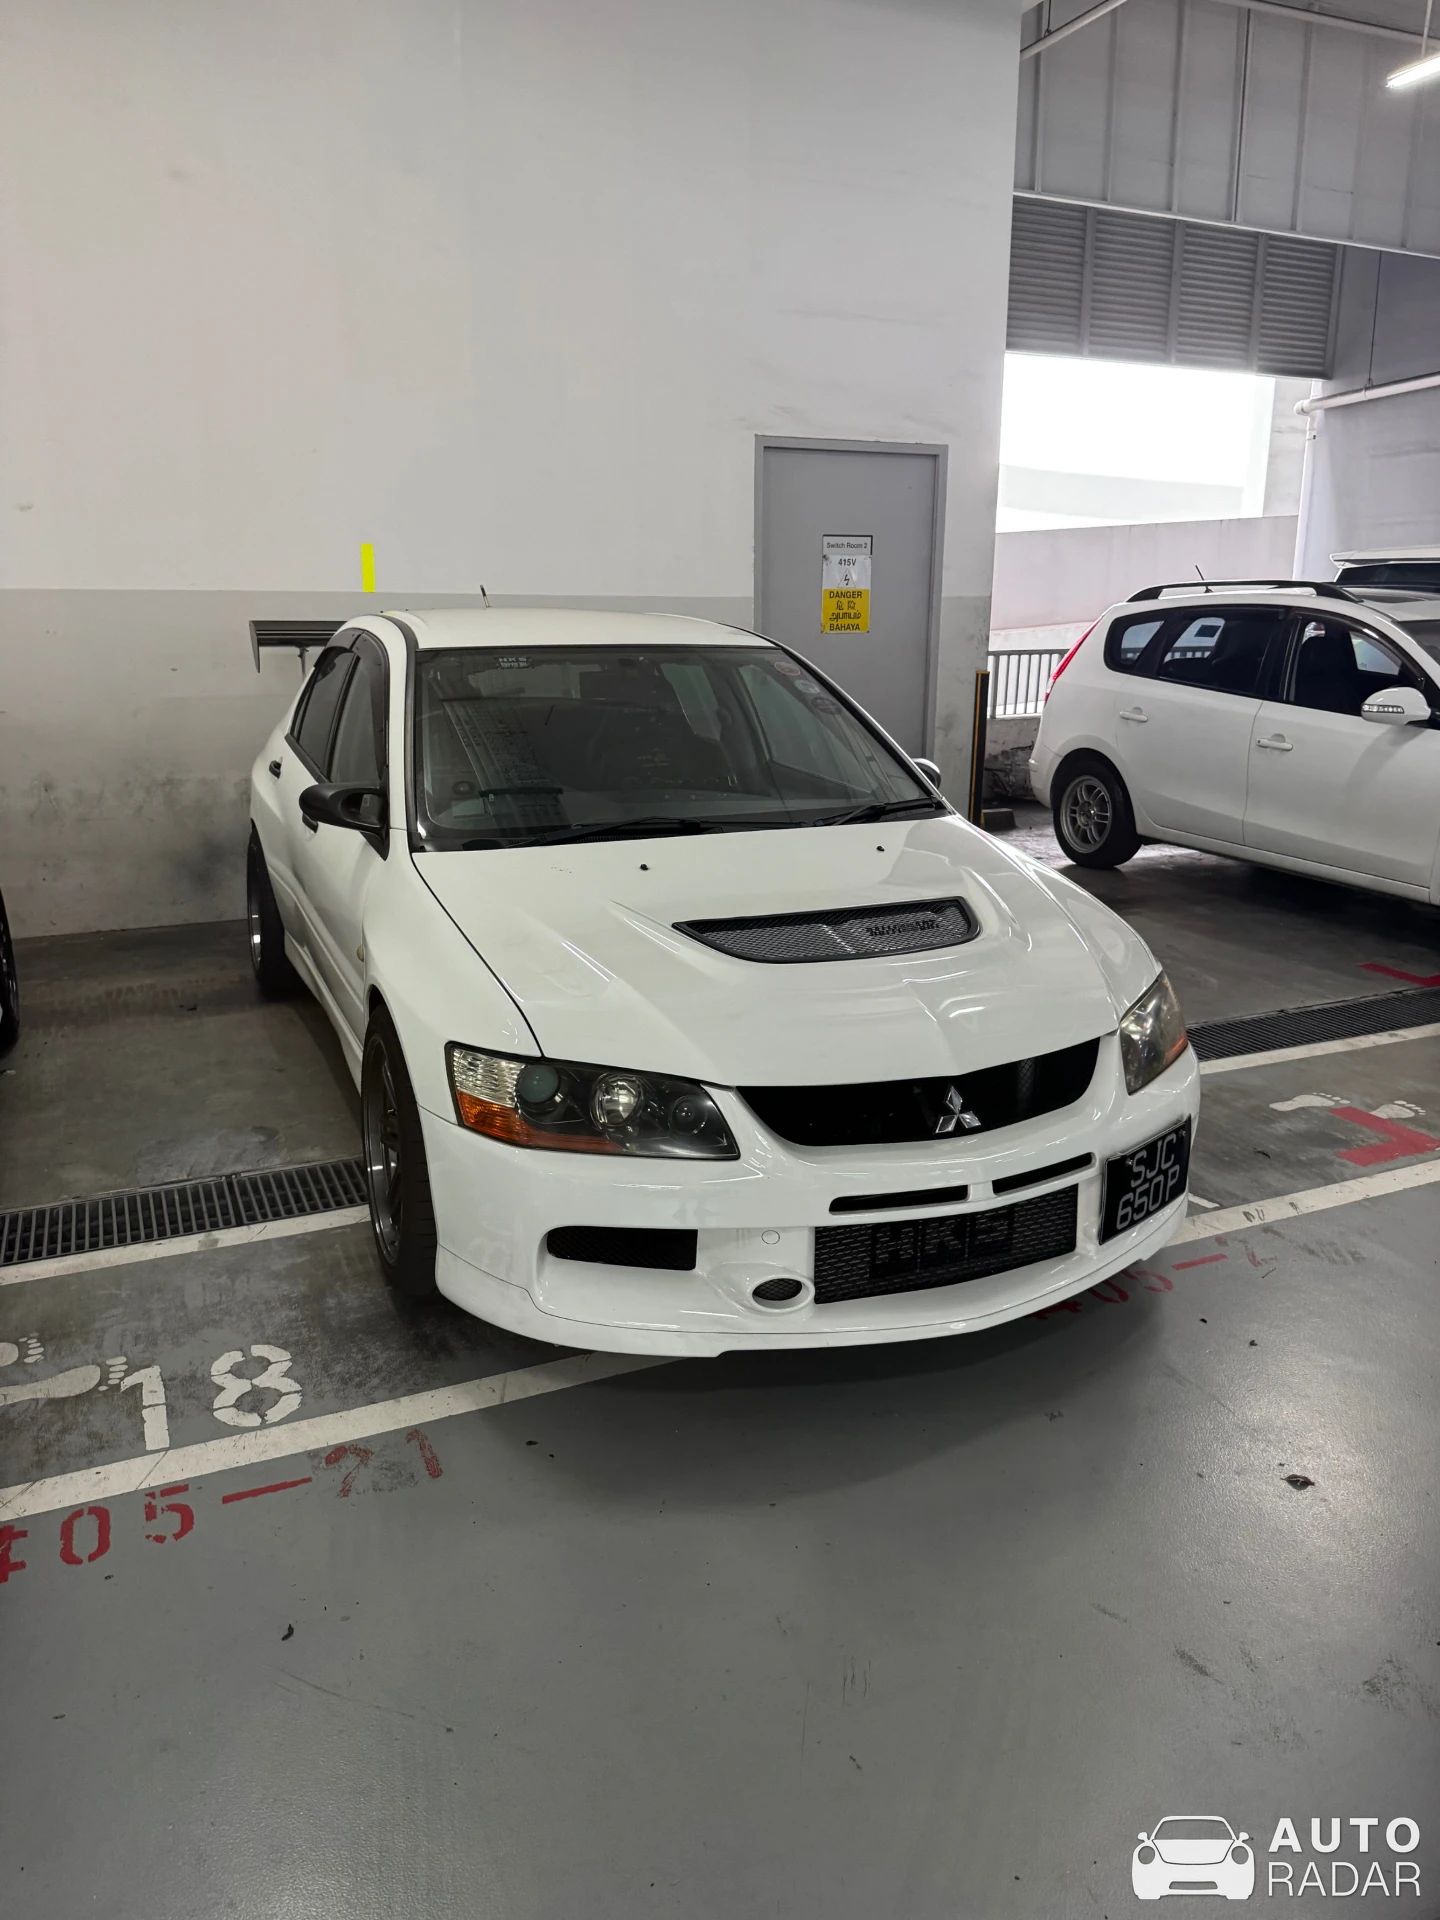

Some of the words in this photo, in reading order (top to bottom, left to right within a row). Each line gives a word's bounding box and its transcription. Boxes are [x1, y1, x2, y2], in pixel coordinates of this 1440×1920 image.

[838, 558, 857, 566] 415V
[829, 591, 863, 599] DANGER
[829, 623, 861, 631] BAHAYA
[1131, 1132, 1177, 1188] SJC
[1116, 1164, 1180, 1230] 650P
[120, 1344, 303, 1451] 18
